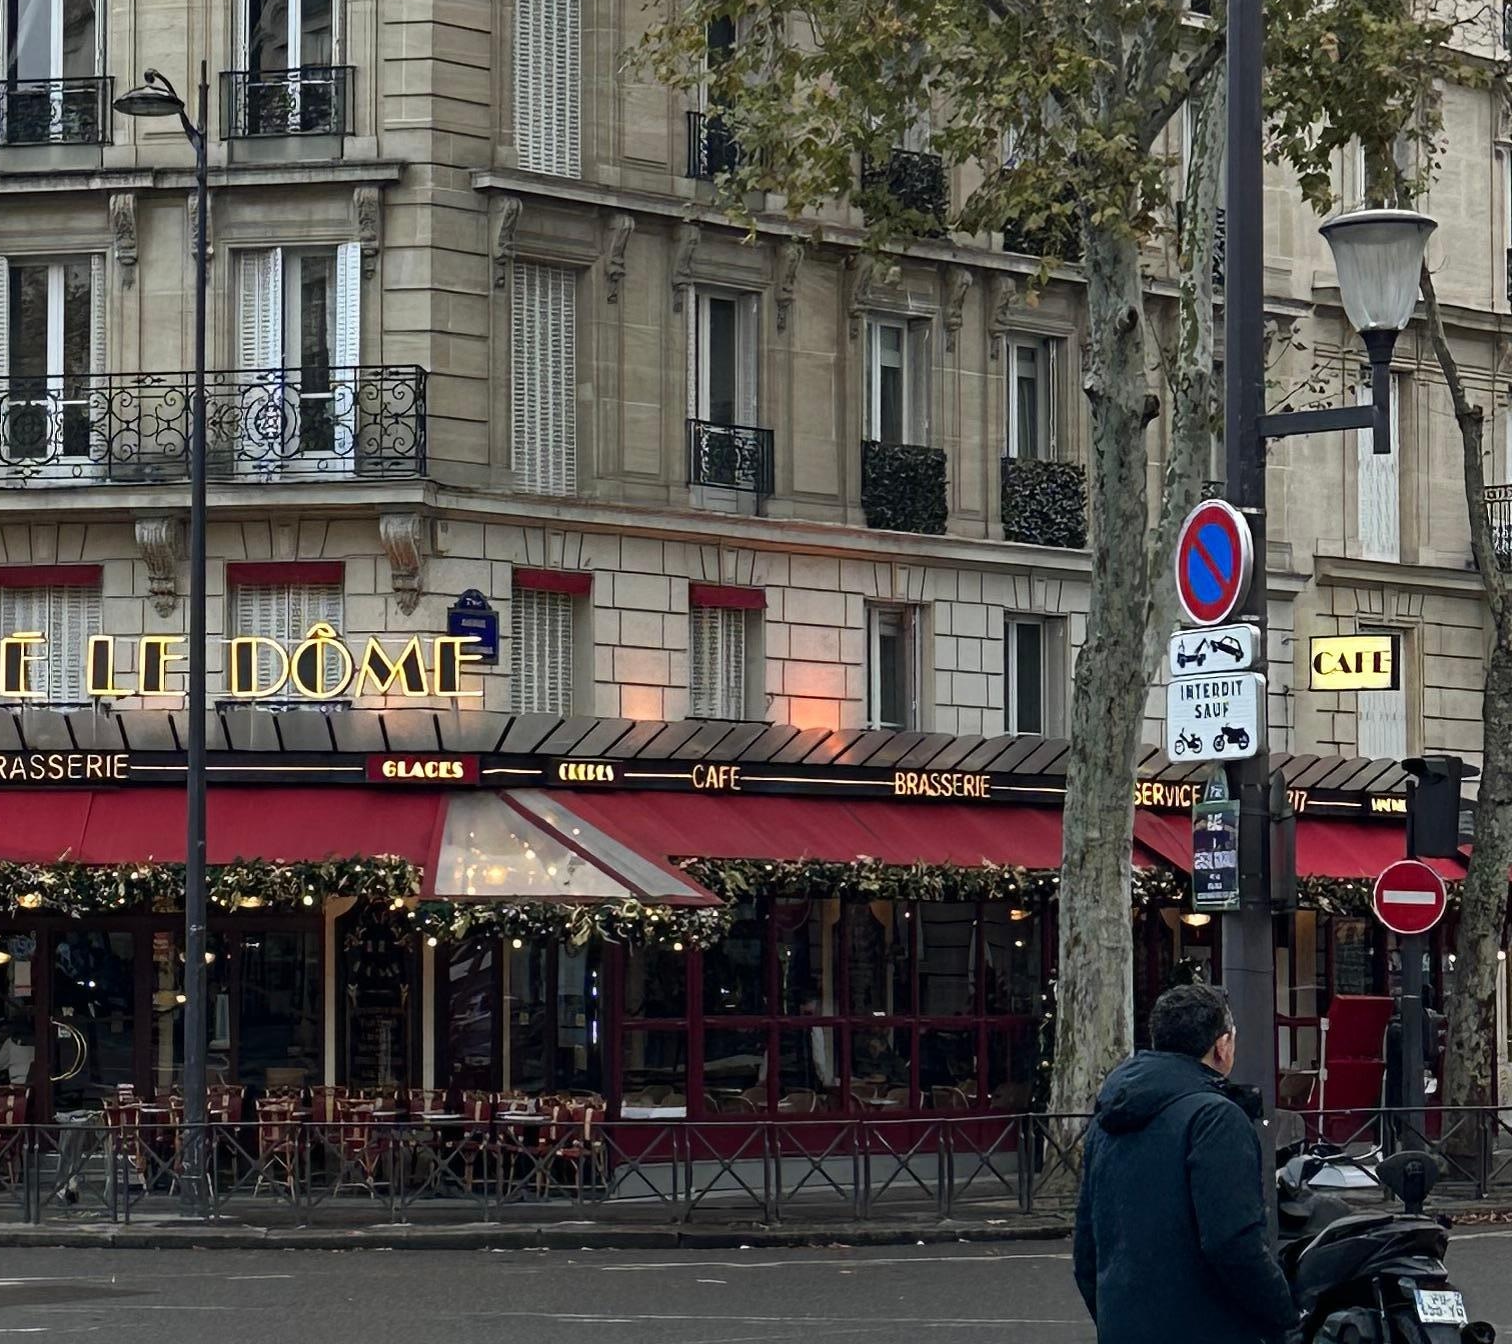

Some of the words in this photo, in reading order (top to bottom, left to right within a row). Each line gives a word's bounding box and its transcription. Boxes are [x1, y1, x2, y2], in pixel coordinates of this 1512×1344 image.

[86, 634, 188, 698] LE
[229, 621, 484, 699] DÔME
[1180, 679, 1243, 701] INTERDIT
[1194, 702, 1231, 719] SAUF
[382, 760, 464, 779] GLACES
[894, 772, 991, 798] BRASSERIE
